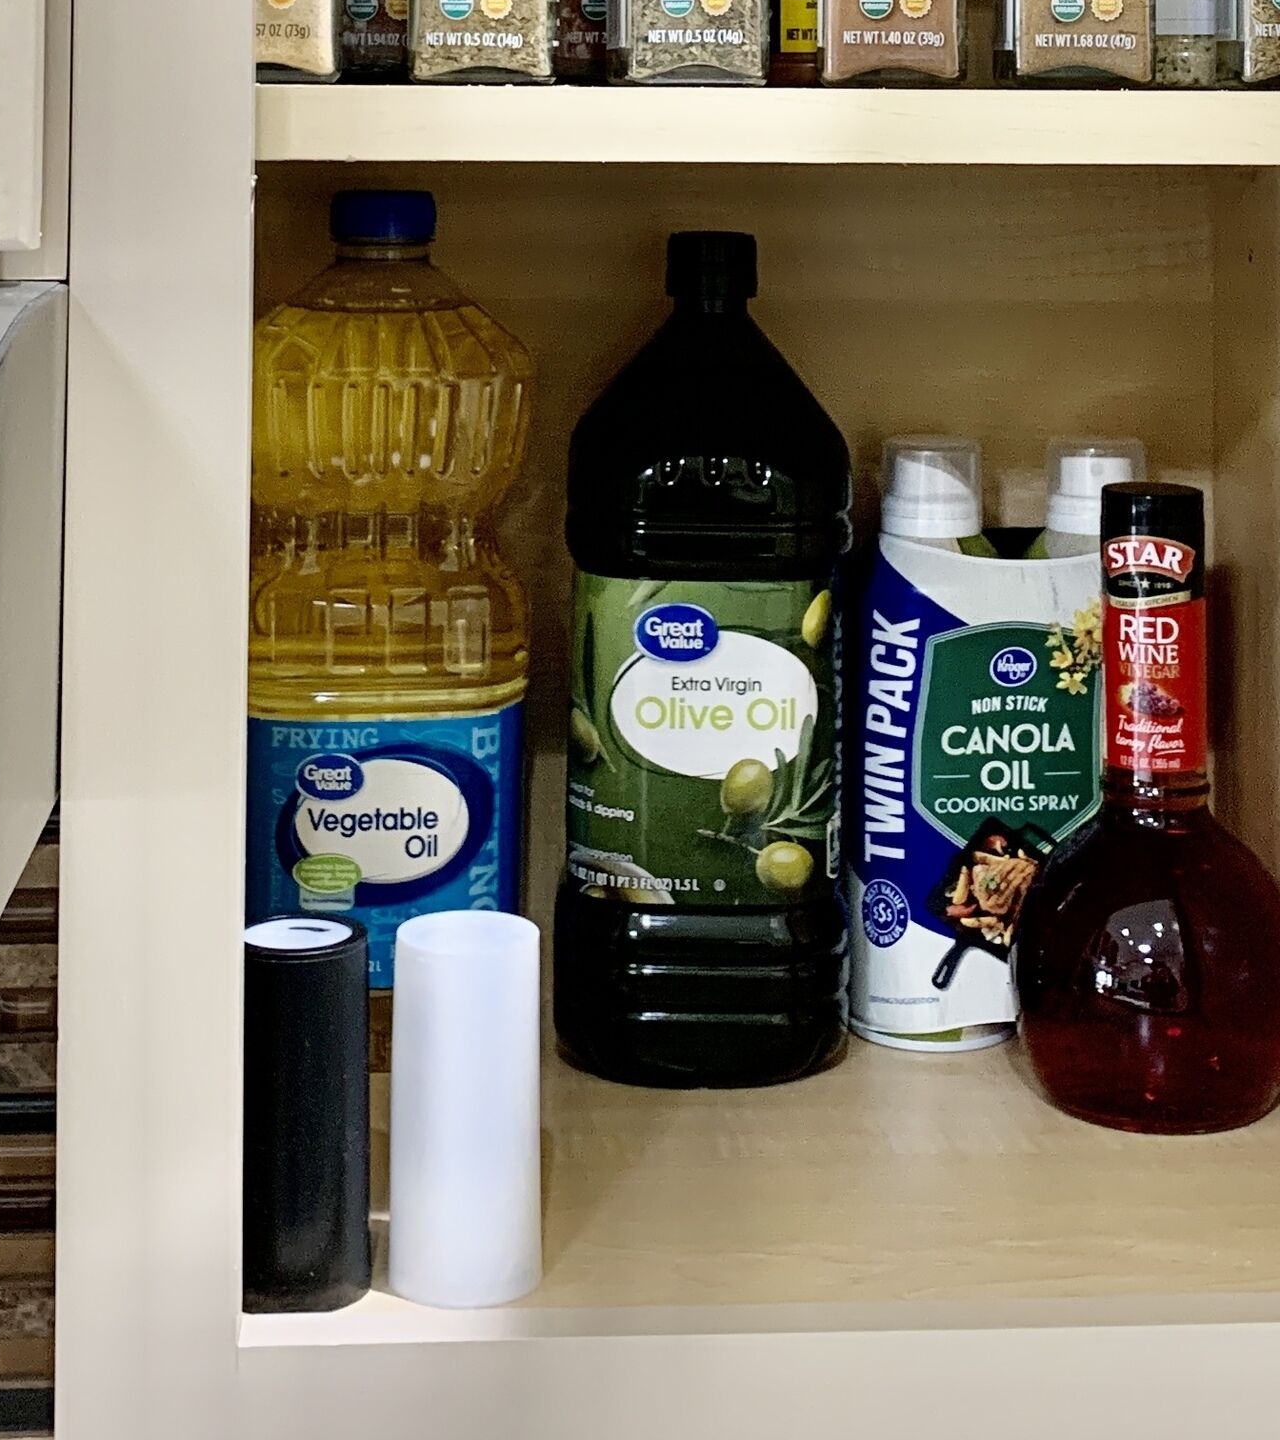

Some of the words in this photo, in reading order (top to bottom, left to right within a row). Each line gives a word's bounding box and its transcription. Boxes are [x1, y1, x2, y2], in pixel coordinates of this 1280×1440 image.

[270, 24, 282, 36] OZ
[284, 24, 310, 39] (73g)
[426, 32, 444, 45] NET
[446, 33, 462, 46] WT
[464, 33, 480, 46] 0.5
[483, 33, 496, 46] OZ
[498, 34, 523, 48] (14g)
[648, 30, 665, 43] NET
[667, 30, 683, 43] WT
[686, 30, 701, 43] 0.5
[704, 30, 716, 43] OZ
[718, 30, 743, 44] (14g)
[786, 28, 799, 40] NET
[802, 29, 813, 40] WT
[843, 31, 861, 44] NET
[864, 31, 879, 44] WT
[882, 31, 901, 44] 1.40
[904, 32, 916, 45] OZ
[918, 32, 944, 46] (39g)
[1255, 24, 1272, 37] NET
[1035, 34, 1053, 47] NET
[1055, 34, 1071, 47] WT
[1074, 34, 1092, 47] 1.68
[1096, 34, 1108, 47] OZ
[1110, 34, 1135, 49] (47g)
[1108, 541, 1183, 574] STAR
[646, 617, 704, 637] Great
[1120, 614, 1179, 644] RED
[659, 635, 703, 650] Value
[1118, 641, 1179, 664] WINE
[998, 654, 1031, 680] Kroger
[672, 676, 711, 692] Extra
[715, 676, 762, 695] Virgin
[867, 610, 921, 744] PACK
[635, 696, 733, 731] Olive
[747, 697, 796, 730] Oil
[972, 696, 1001, 715] NON
[1005, 696, 1049, 713] STICK
[1119, 715, 1183, 733] Traditional
[271, 727, 379, 749] FRYING
[941, 723, 1075, 755] CANOLA
[1148, 734, 1184, 753] flavor
[304, 764, 352, 781] Great
[980, 760, 1035, 791] OIL
[315, 778, 352, 791] Value
[864, 749, 906, 862] TWIN
[934, 796, 1024, 813] COOKING
[1029, 795, 1079, 811] SPRAY
[308, 807, 438, 838] Vegetable
[405, 834, 438, 858] Oil
[610, 875, 615, 887] 1
[617, 876, 630, 888] PT
[631, 877, 638, 889] 3
[640, 877, 653, 890] FL
[674, 879, 690, 891] 1.5
[692, 879, 700, 891] L
[865, 884, 878, 903] BEST
[880, 884, 905, 910] VALUE
